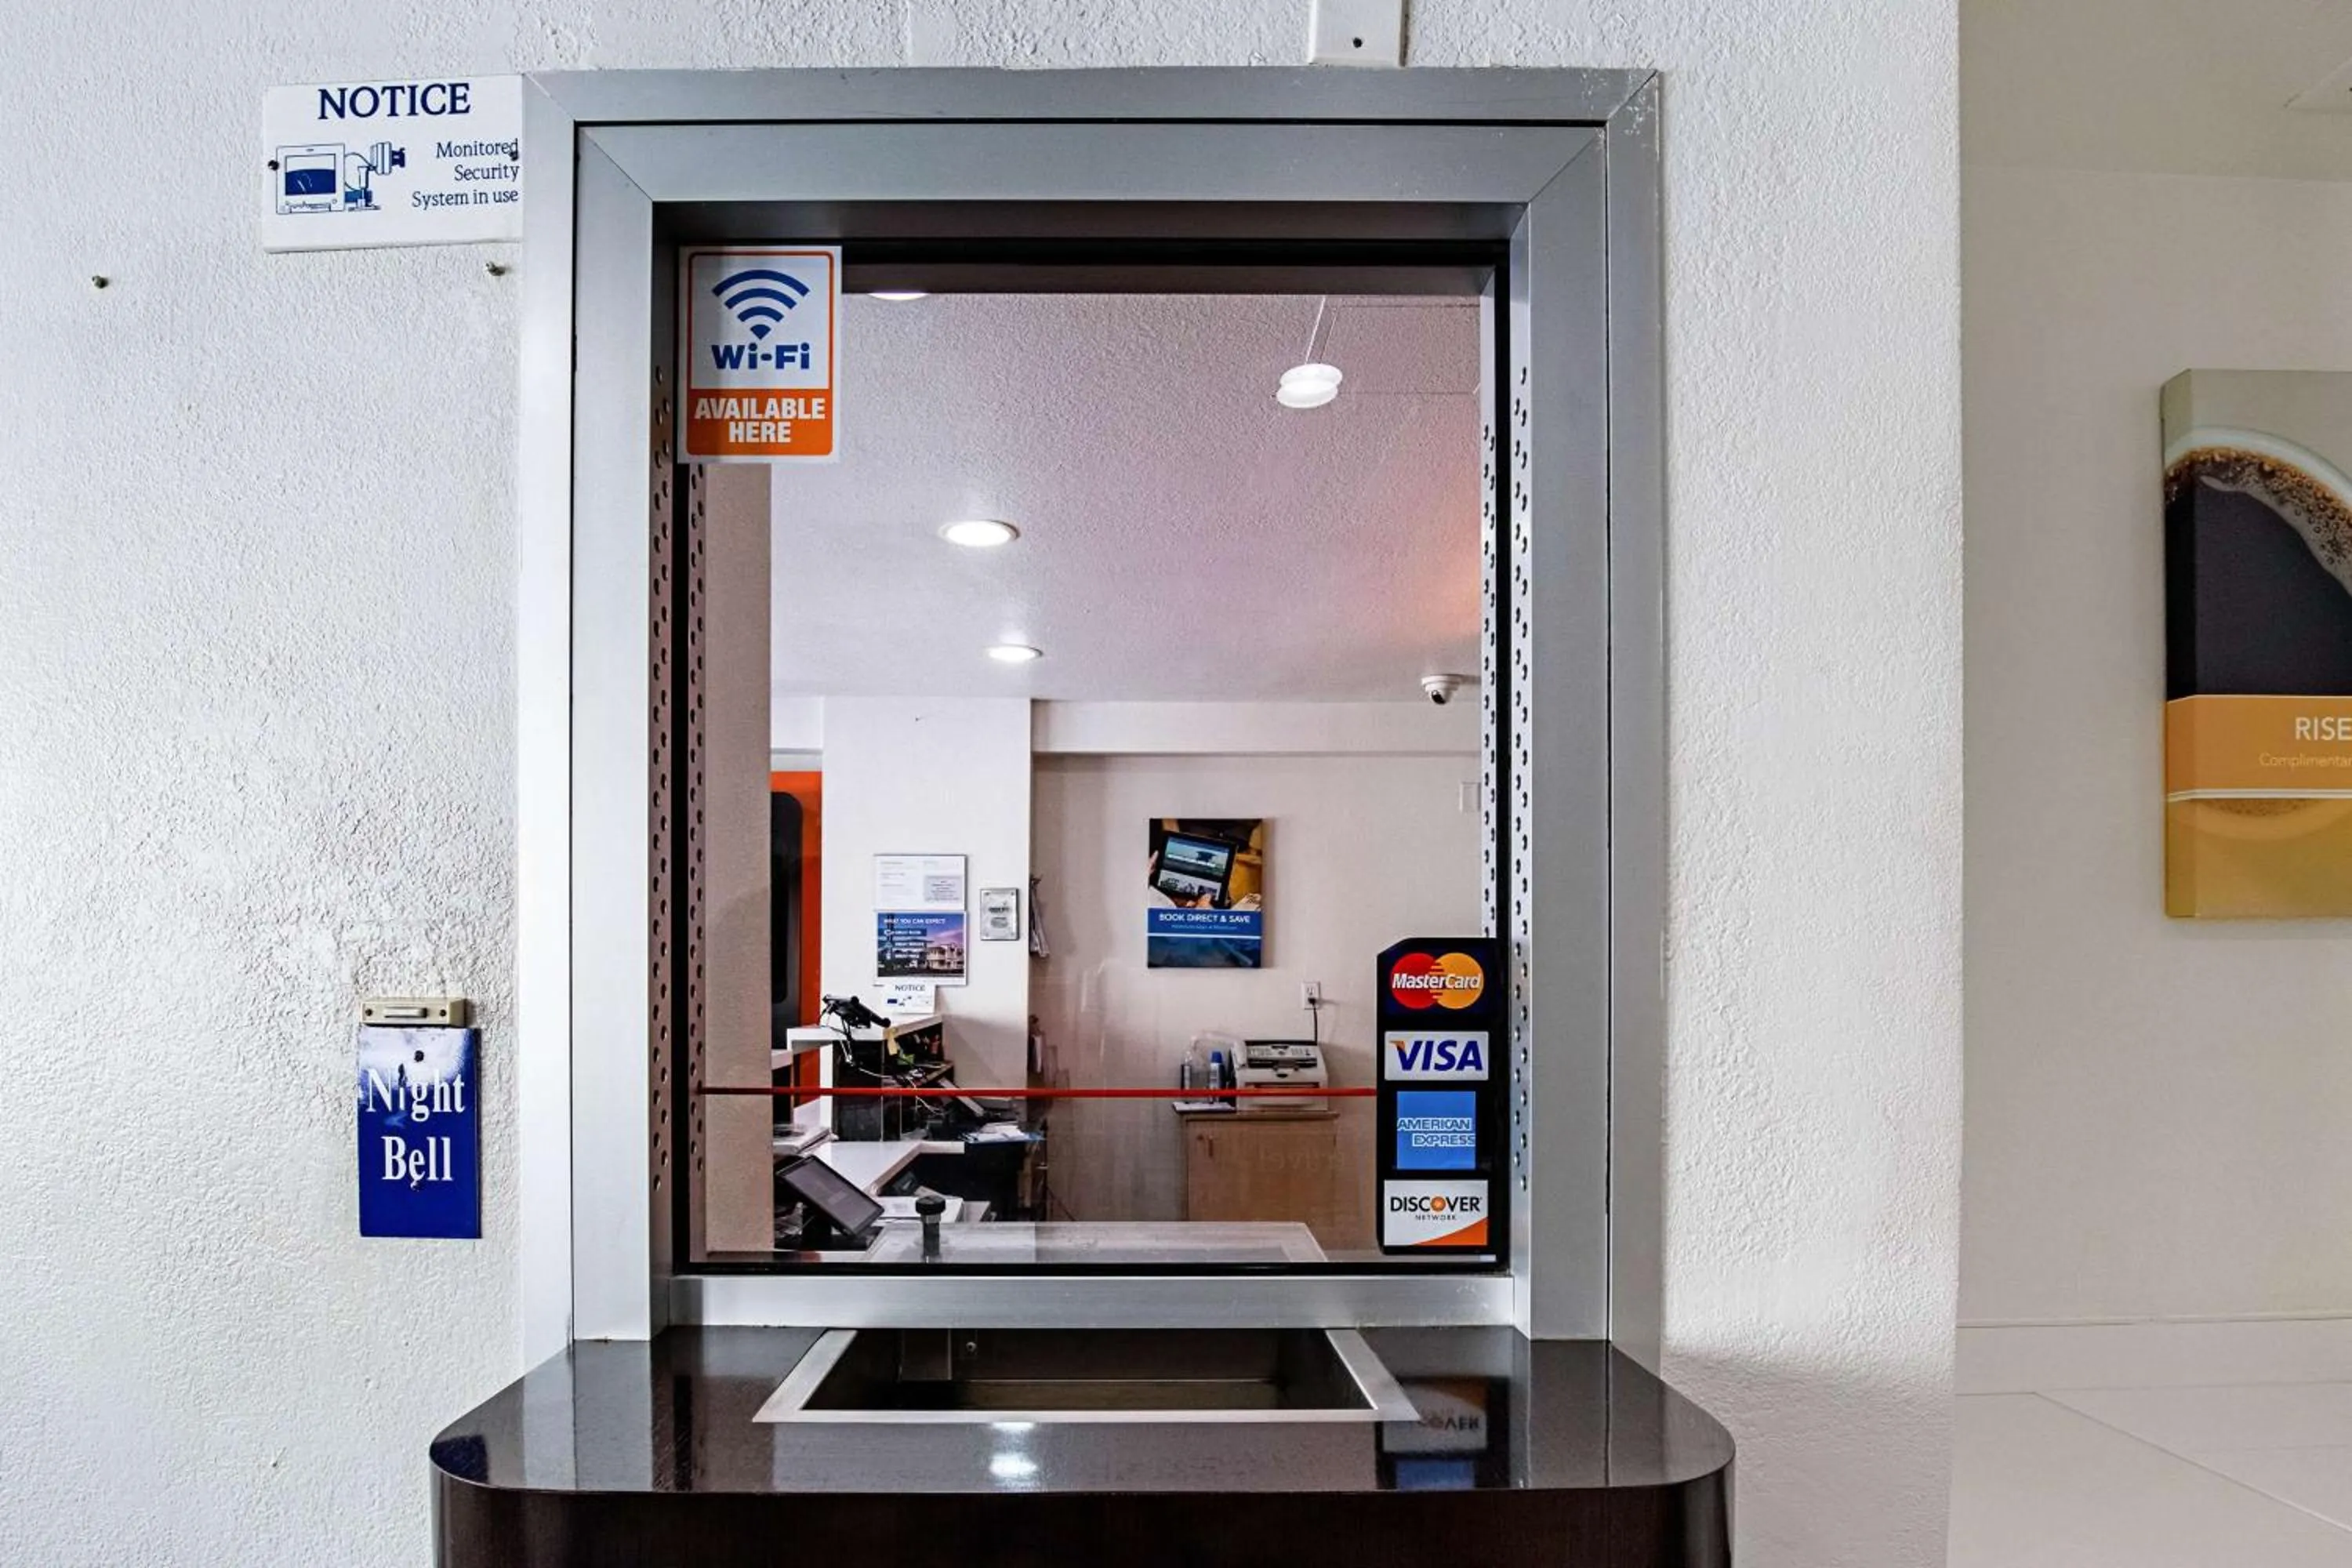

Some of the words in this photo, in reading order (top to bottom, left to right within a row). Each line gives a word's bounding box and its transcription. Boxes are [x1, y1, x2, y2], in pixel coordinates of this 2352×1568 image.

[318, 83, 471, 119] NOTICE
[436, 138, 518, 159] Monitored
[454, 164, 520, 183] Security
[412, 191, 470, 210] System
[473, 191, 489, 205] in
[492, 191, 518, 205] use
[711, 342, 810, 369] Wi-Fi
[694, 397, 826, 419] AVAILABLE
[728, 421, 792, 443] HERE
[2295, 717, 2352, 741] RISE
[1159, 913, 1185, 922] BOOK
[1187, 913, 1218, 923] DIRECT
[1229, 915, 1251, 924] SAVE
[1392, 972, 1482, 990] MasterCard
[1388, 1040, 1483, 1072] VISA
[365, 1065, 465, 1122] Night
[1397, 1118, 1472, 1131] AMERICAN
[1413, 1134, 1475, 1147] EXPRESS
[381, 1135, 453, 1181] Bell
[1389, 1196, 1481, 1213] DISCOVER
